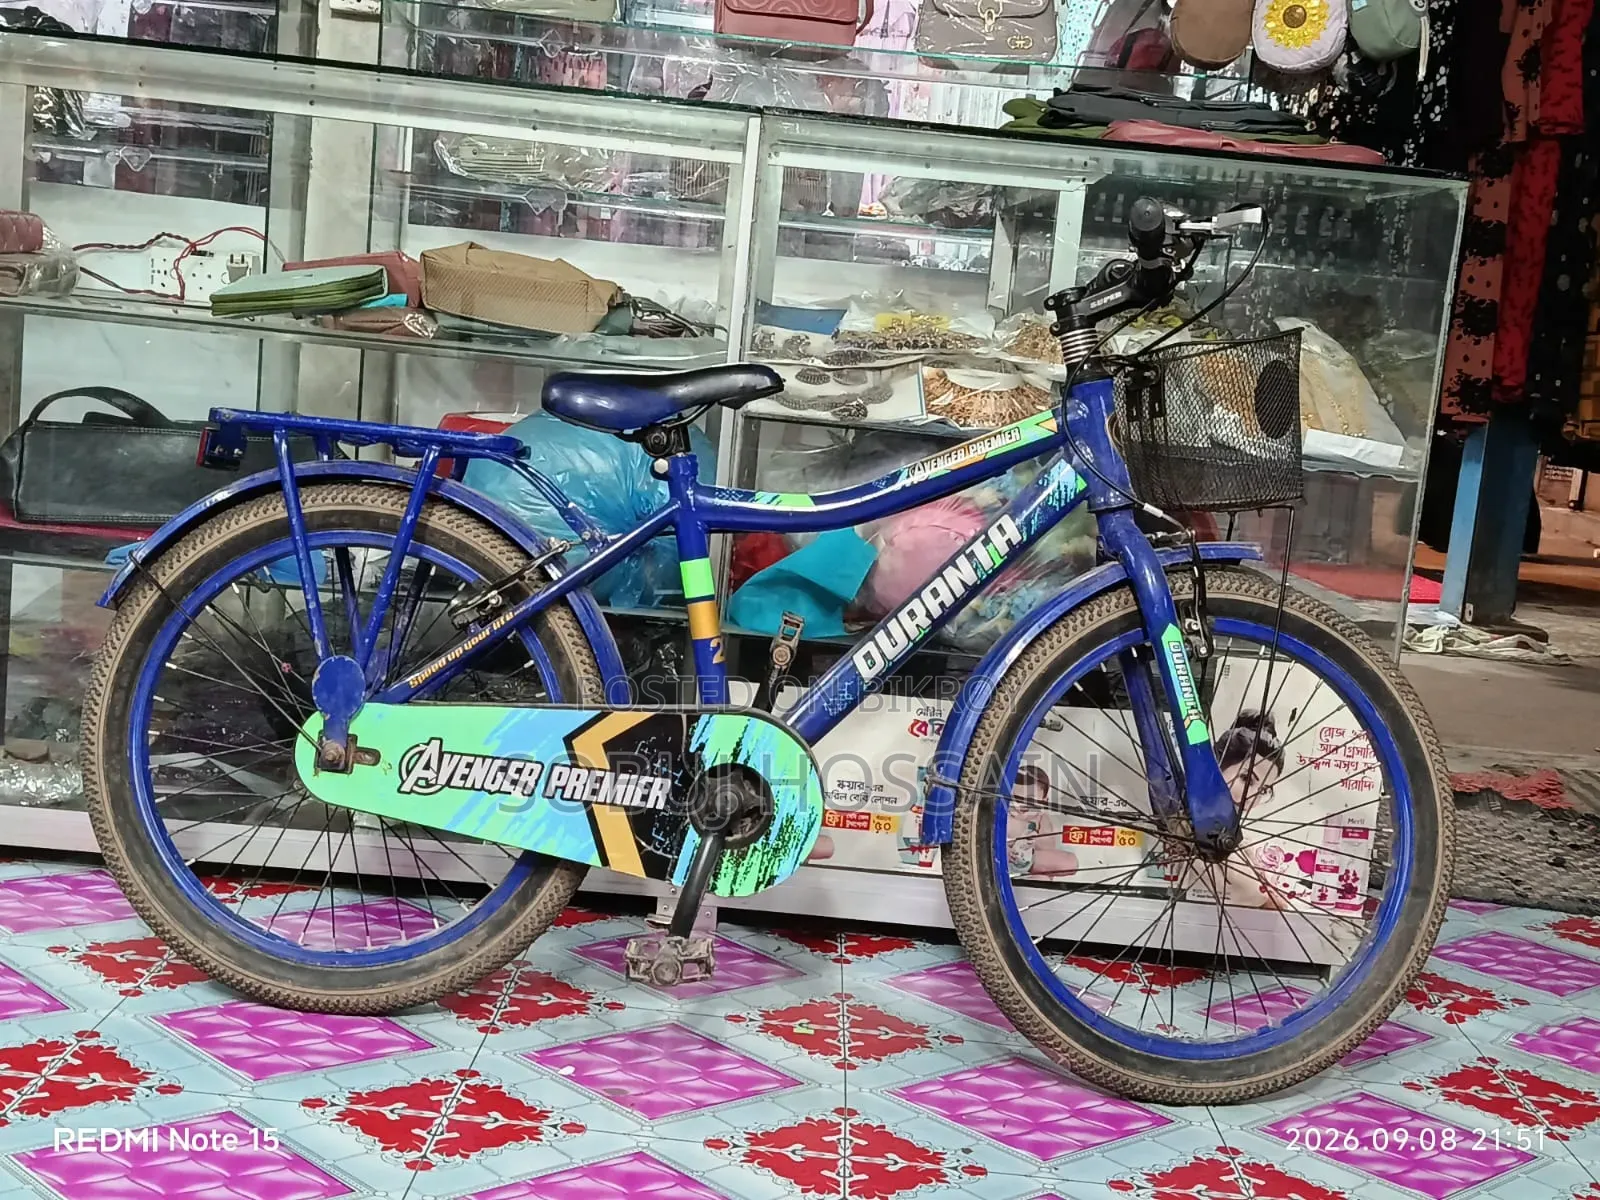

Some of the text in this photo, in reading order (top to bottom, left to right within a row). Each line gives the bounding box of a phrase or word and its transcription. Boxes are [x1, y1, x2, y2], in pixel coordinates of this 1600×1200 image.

[1089, 290, 1123, 310] SUPER
[967, 427, 1022, 459] PREMIER
[851, 513, 1023, 684] DURANTA
[463, 628, 492, 652] your
[400, 737, 672, 811] AVENGER PREMIER
